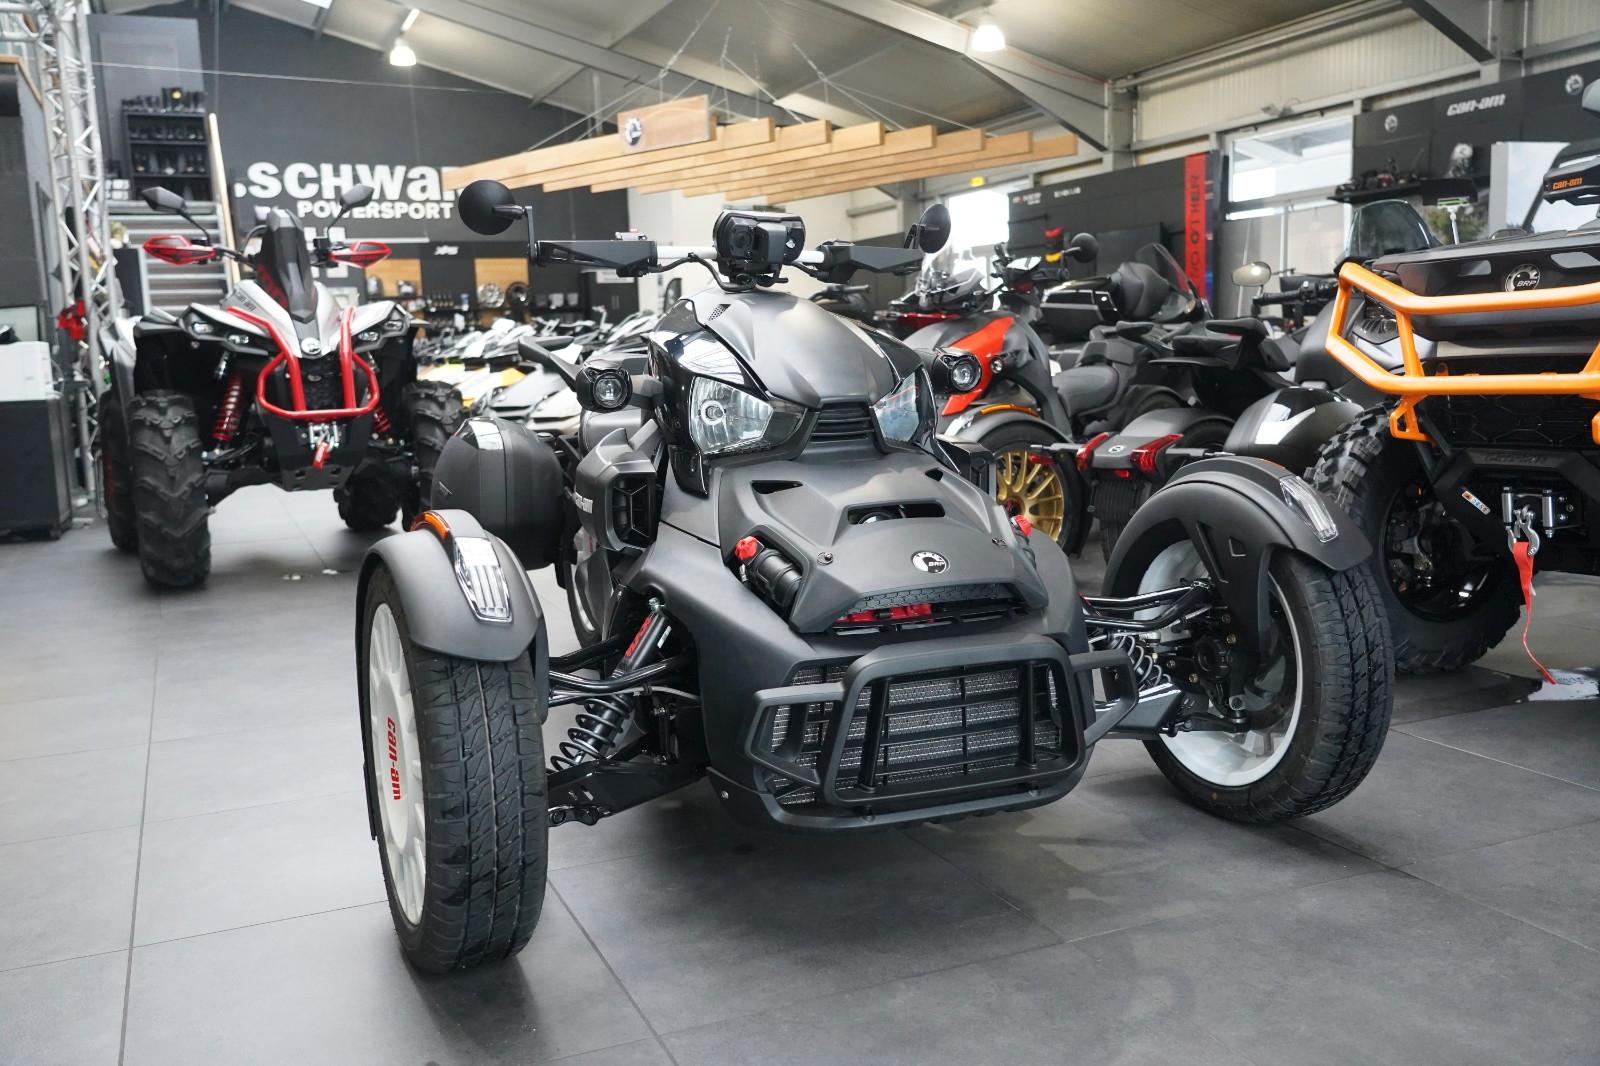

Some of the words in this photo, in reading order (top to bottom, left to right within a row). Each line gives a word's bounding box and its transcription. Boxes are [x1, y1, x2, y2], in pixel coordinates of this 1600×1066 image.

[1447, 93, 1506, 117] can-am
[1552, 177, 1583, 190] can-am
[387, 716, 402, 800] can-am
